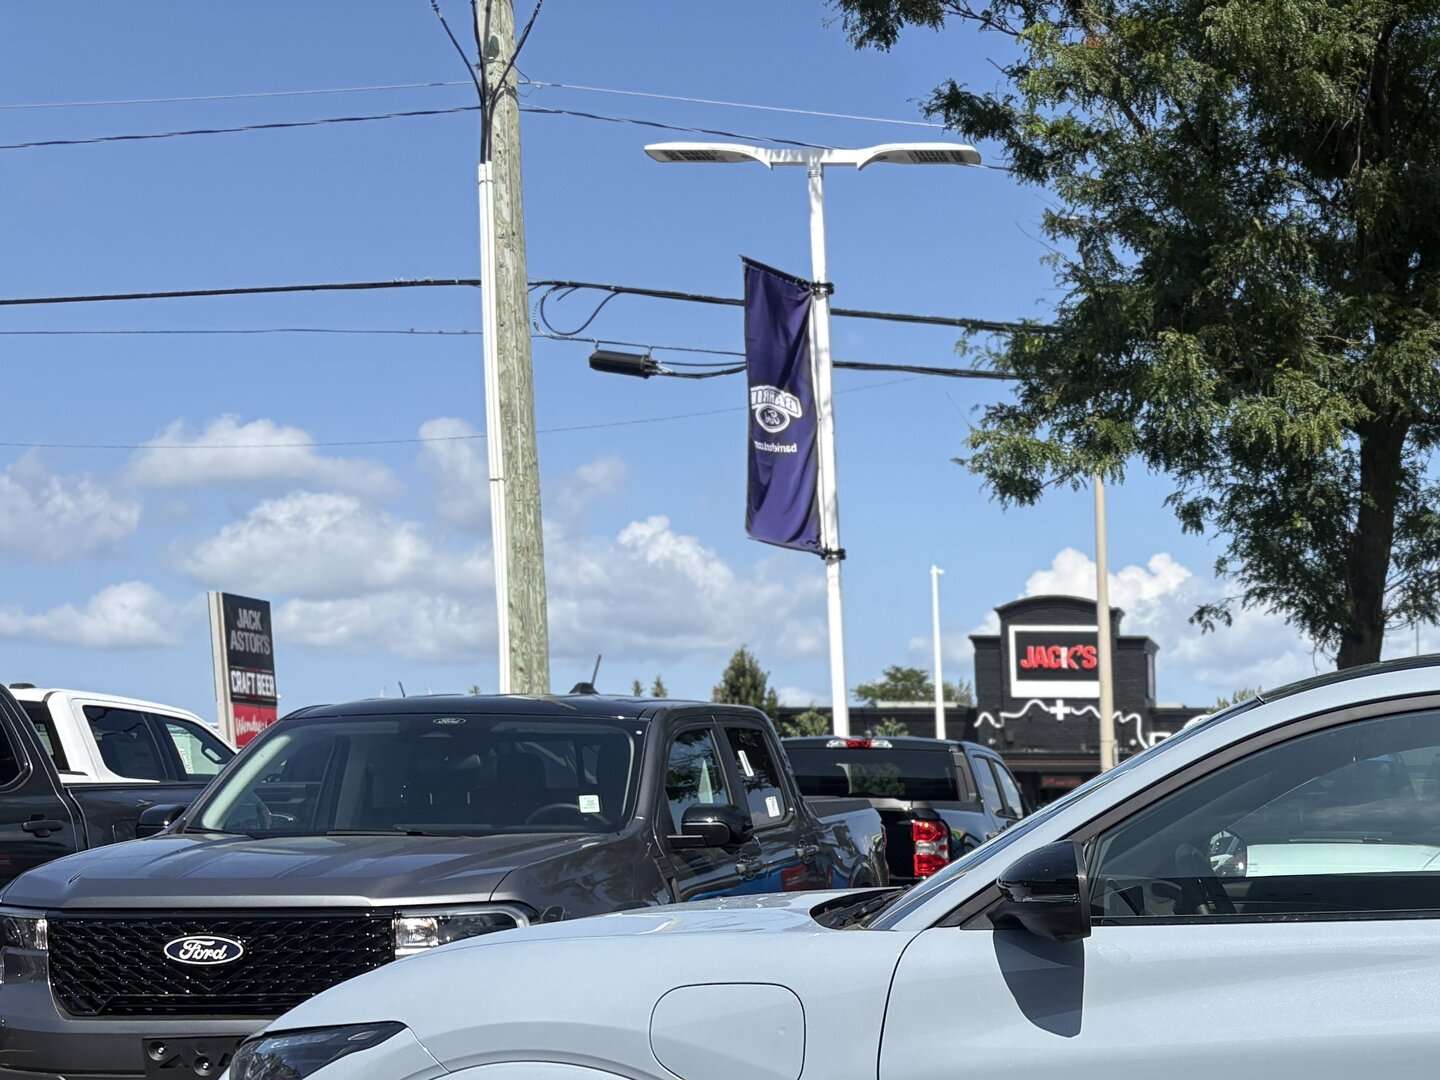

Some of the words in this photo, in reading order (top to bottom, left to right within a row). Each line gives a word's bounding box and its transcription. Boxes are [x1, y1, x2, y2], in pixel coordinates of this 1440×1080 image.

[237, 607, 262, 631] JACK
[230, 630, 271, 655] ASTOR'S
[1020, 645, 1097, 669] JACK'S
[231, 671, 256, 695] CRAFT
[257, 673, 274, 696] BEER
[179, 940, 227, 959] Ford
